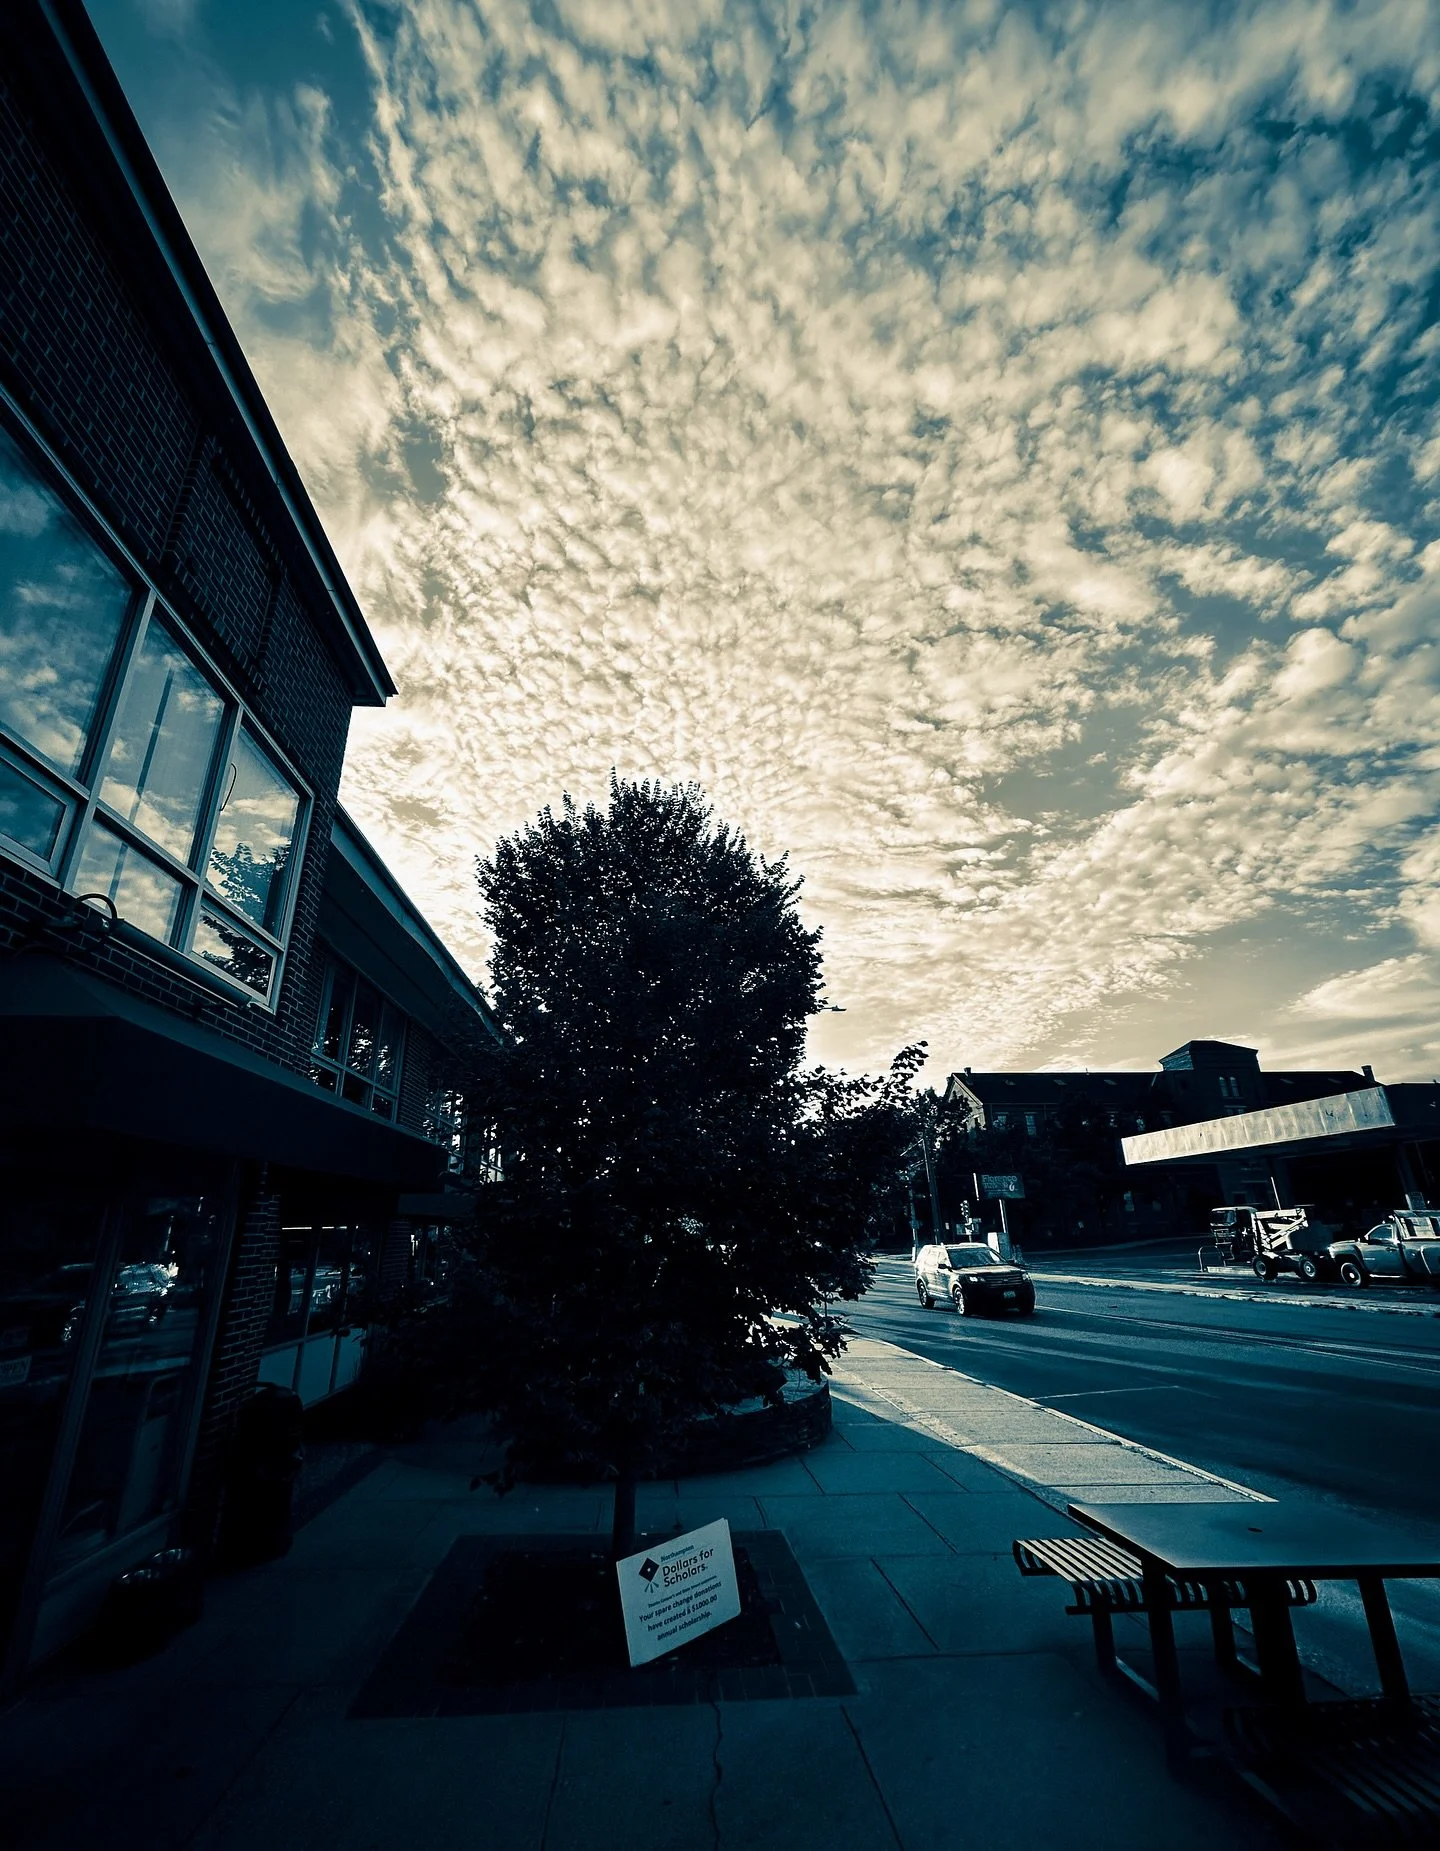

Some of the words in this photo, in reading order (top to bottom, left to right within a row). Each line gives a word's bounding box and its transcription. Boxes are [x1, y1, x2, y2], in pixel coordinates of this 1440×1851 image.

[661, 1545, 694, 1562] Northampton
[662, 1556, 698, 1577] Dollars
[699, 1548, 714, 1560] for
[639, 1612, 654, 1623] Your
[655, 1605, 672, 1617] spare
[673, 1595, 693, 1608] change
[694, 1581, 722, 1598] donations
[647, 1621, 663, 1632] have
[664, 1609, 686, 1625] created
[657, 1625, 678, 1641] annual
[679, 1611, 712, 1631] scholarship.
